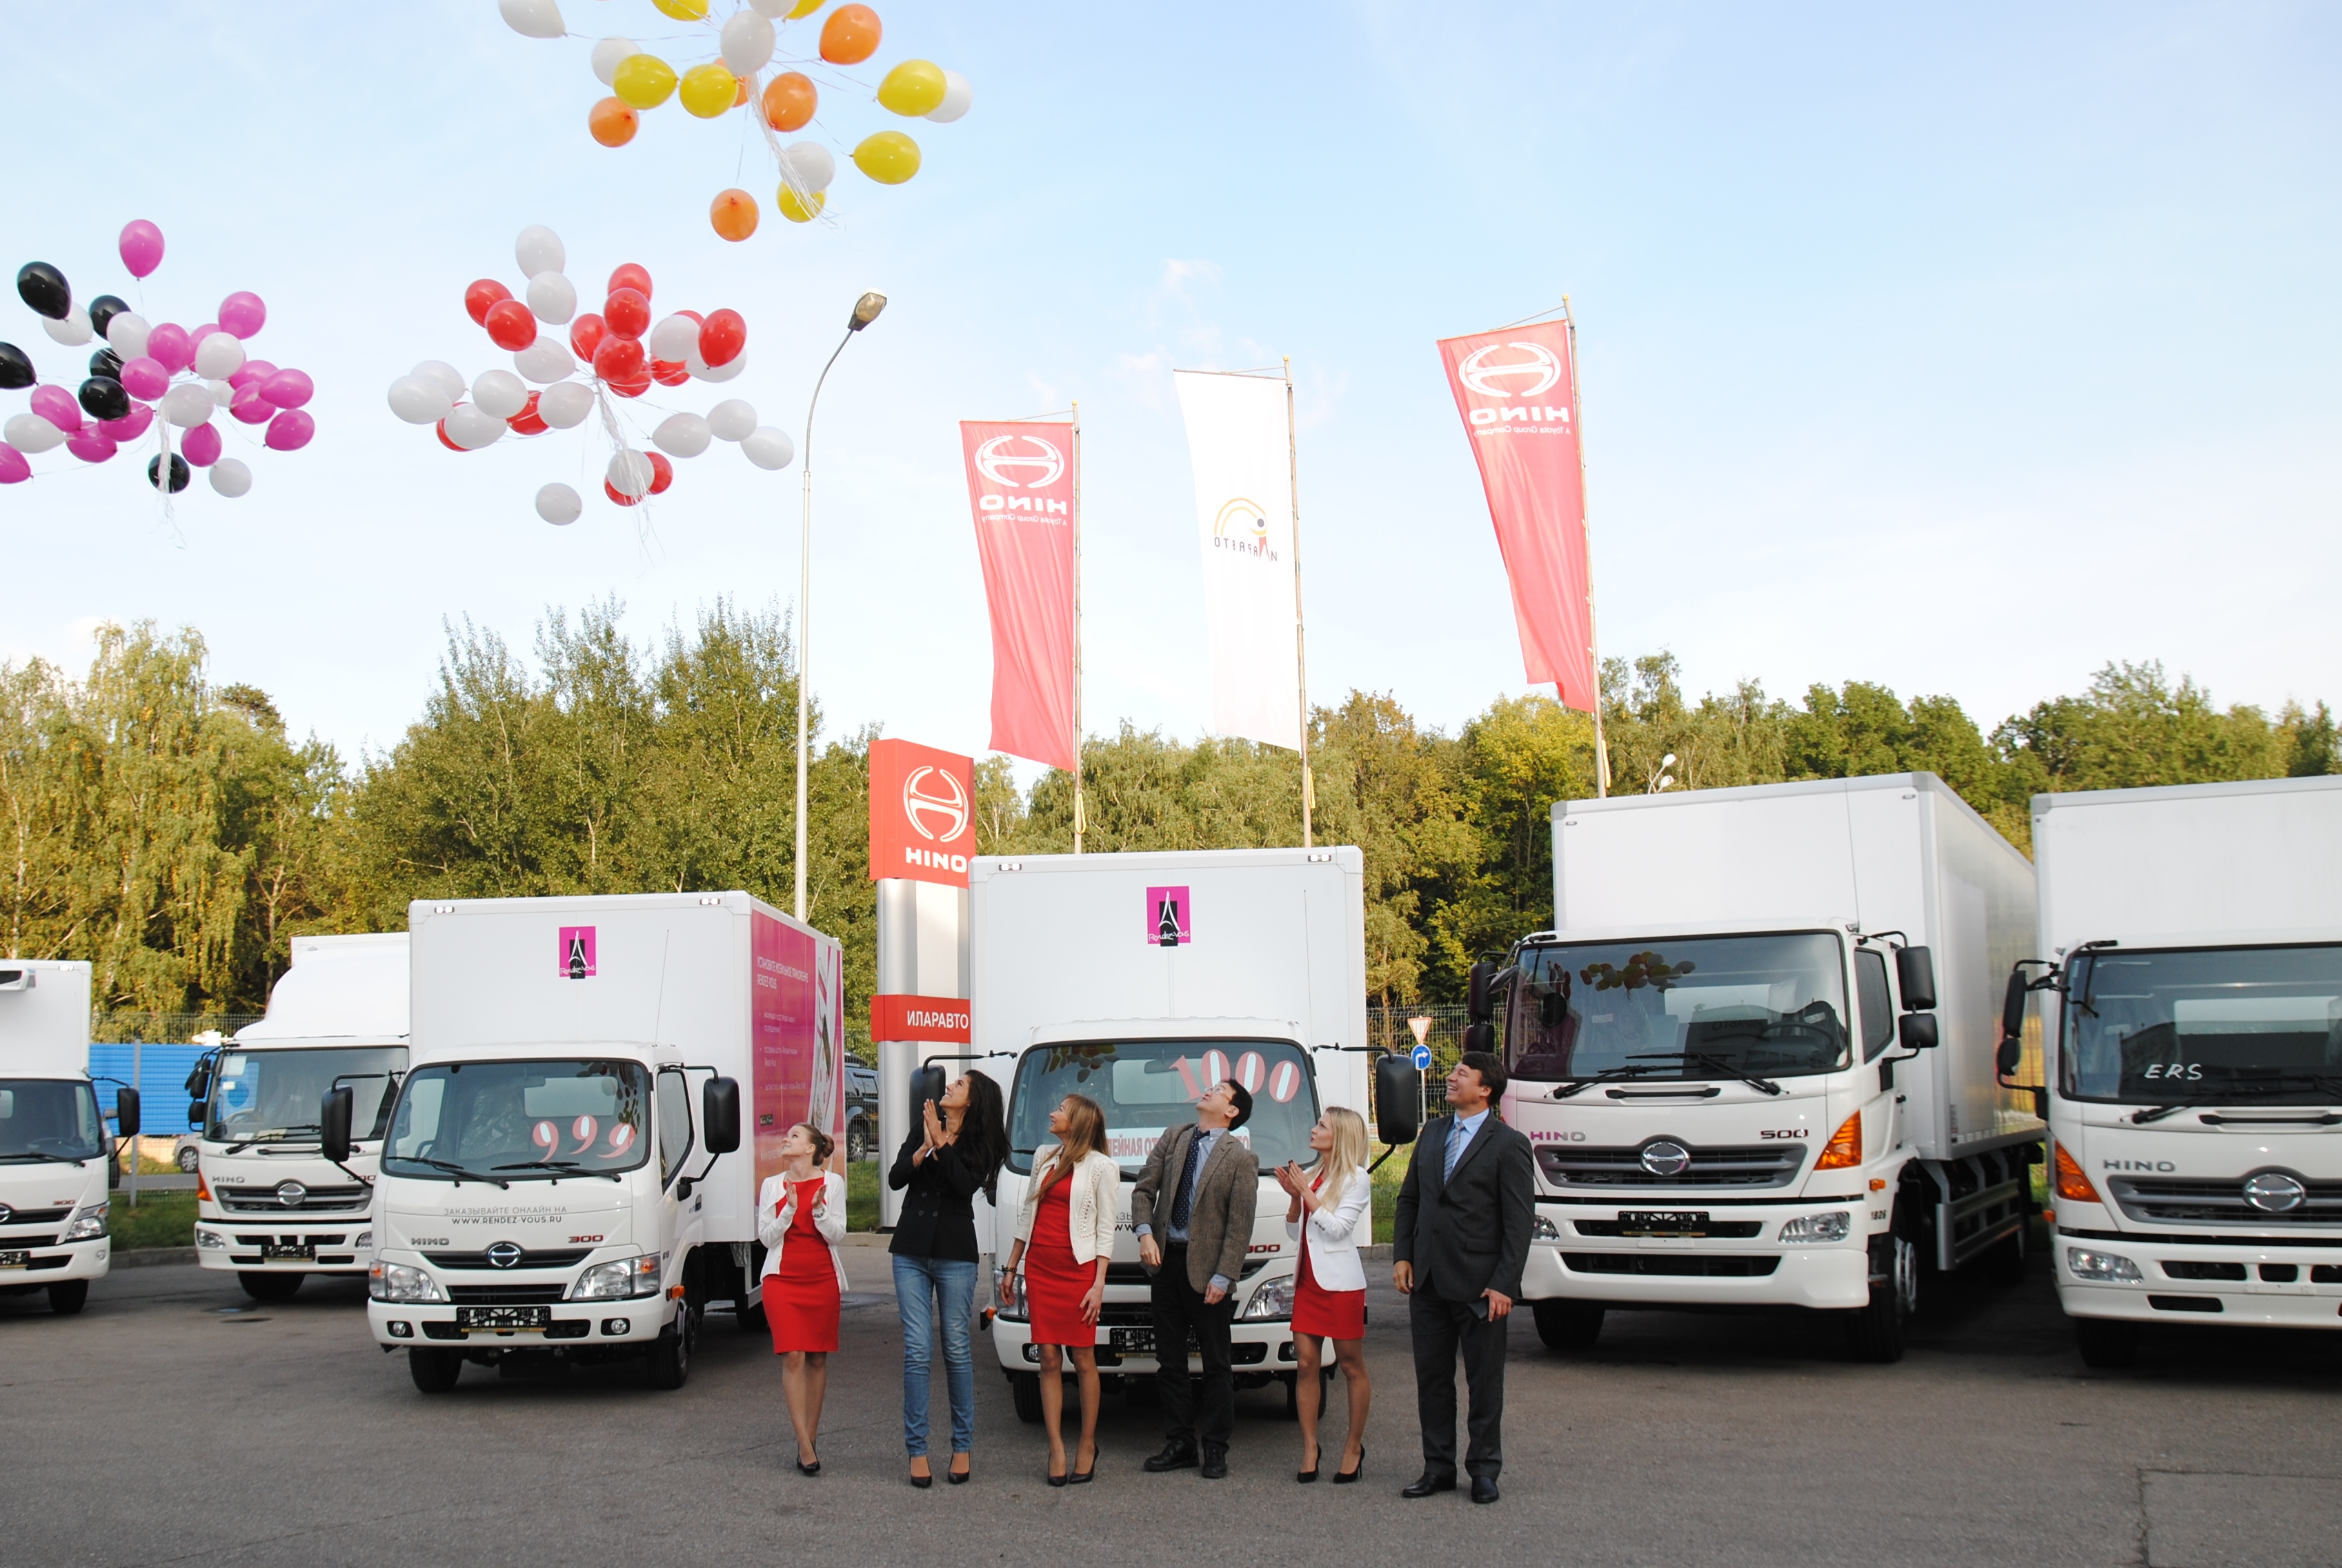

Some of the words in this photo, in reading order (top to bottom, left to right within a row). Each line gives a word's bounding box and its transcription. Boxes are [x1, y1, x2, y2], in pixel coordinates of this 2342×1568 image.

[906, 846, 967, 873] HINO
[907, 1010, 969, 1029] ИЛАРАВТО
[1169, 1049, 1300, 1103] 1000
[2144, 1064, 2203, 1080] ERS
[1530, 1131, 1586, 1142] HINO
[1760, 1129, 1809, 1140] 500
[2103, 1160, 2176, 1172] HINO
[212, 1175, 245, 1184] HINO
[444, 1207, 509, 1216] ЗАКАЗЫВАЙТЕ
[512, 1206, 551, 1215] ОНЛАЙН
[452, 1216, 562, 1224] WWW.RENDEZ-VOUS.RU
[411, 1238, 449, 1246] HINO
[568, 1235, 604, 1243] 300
